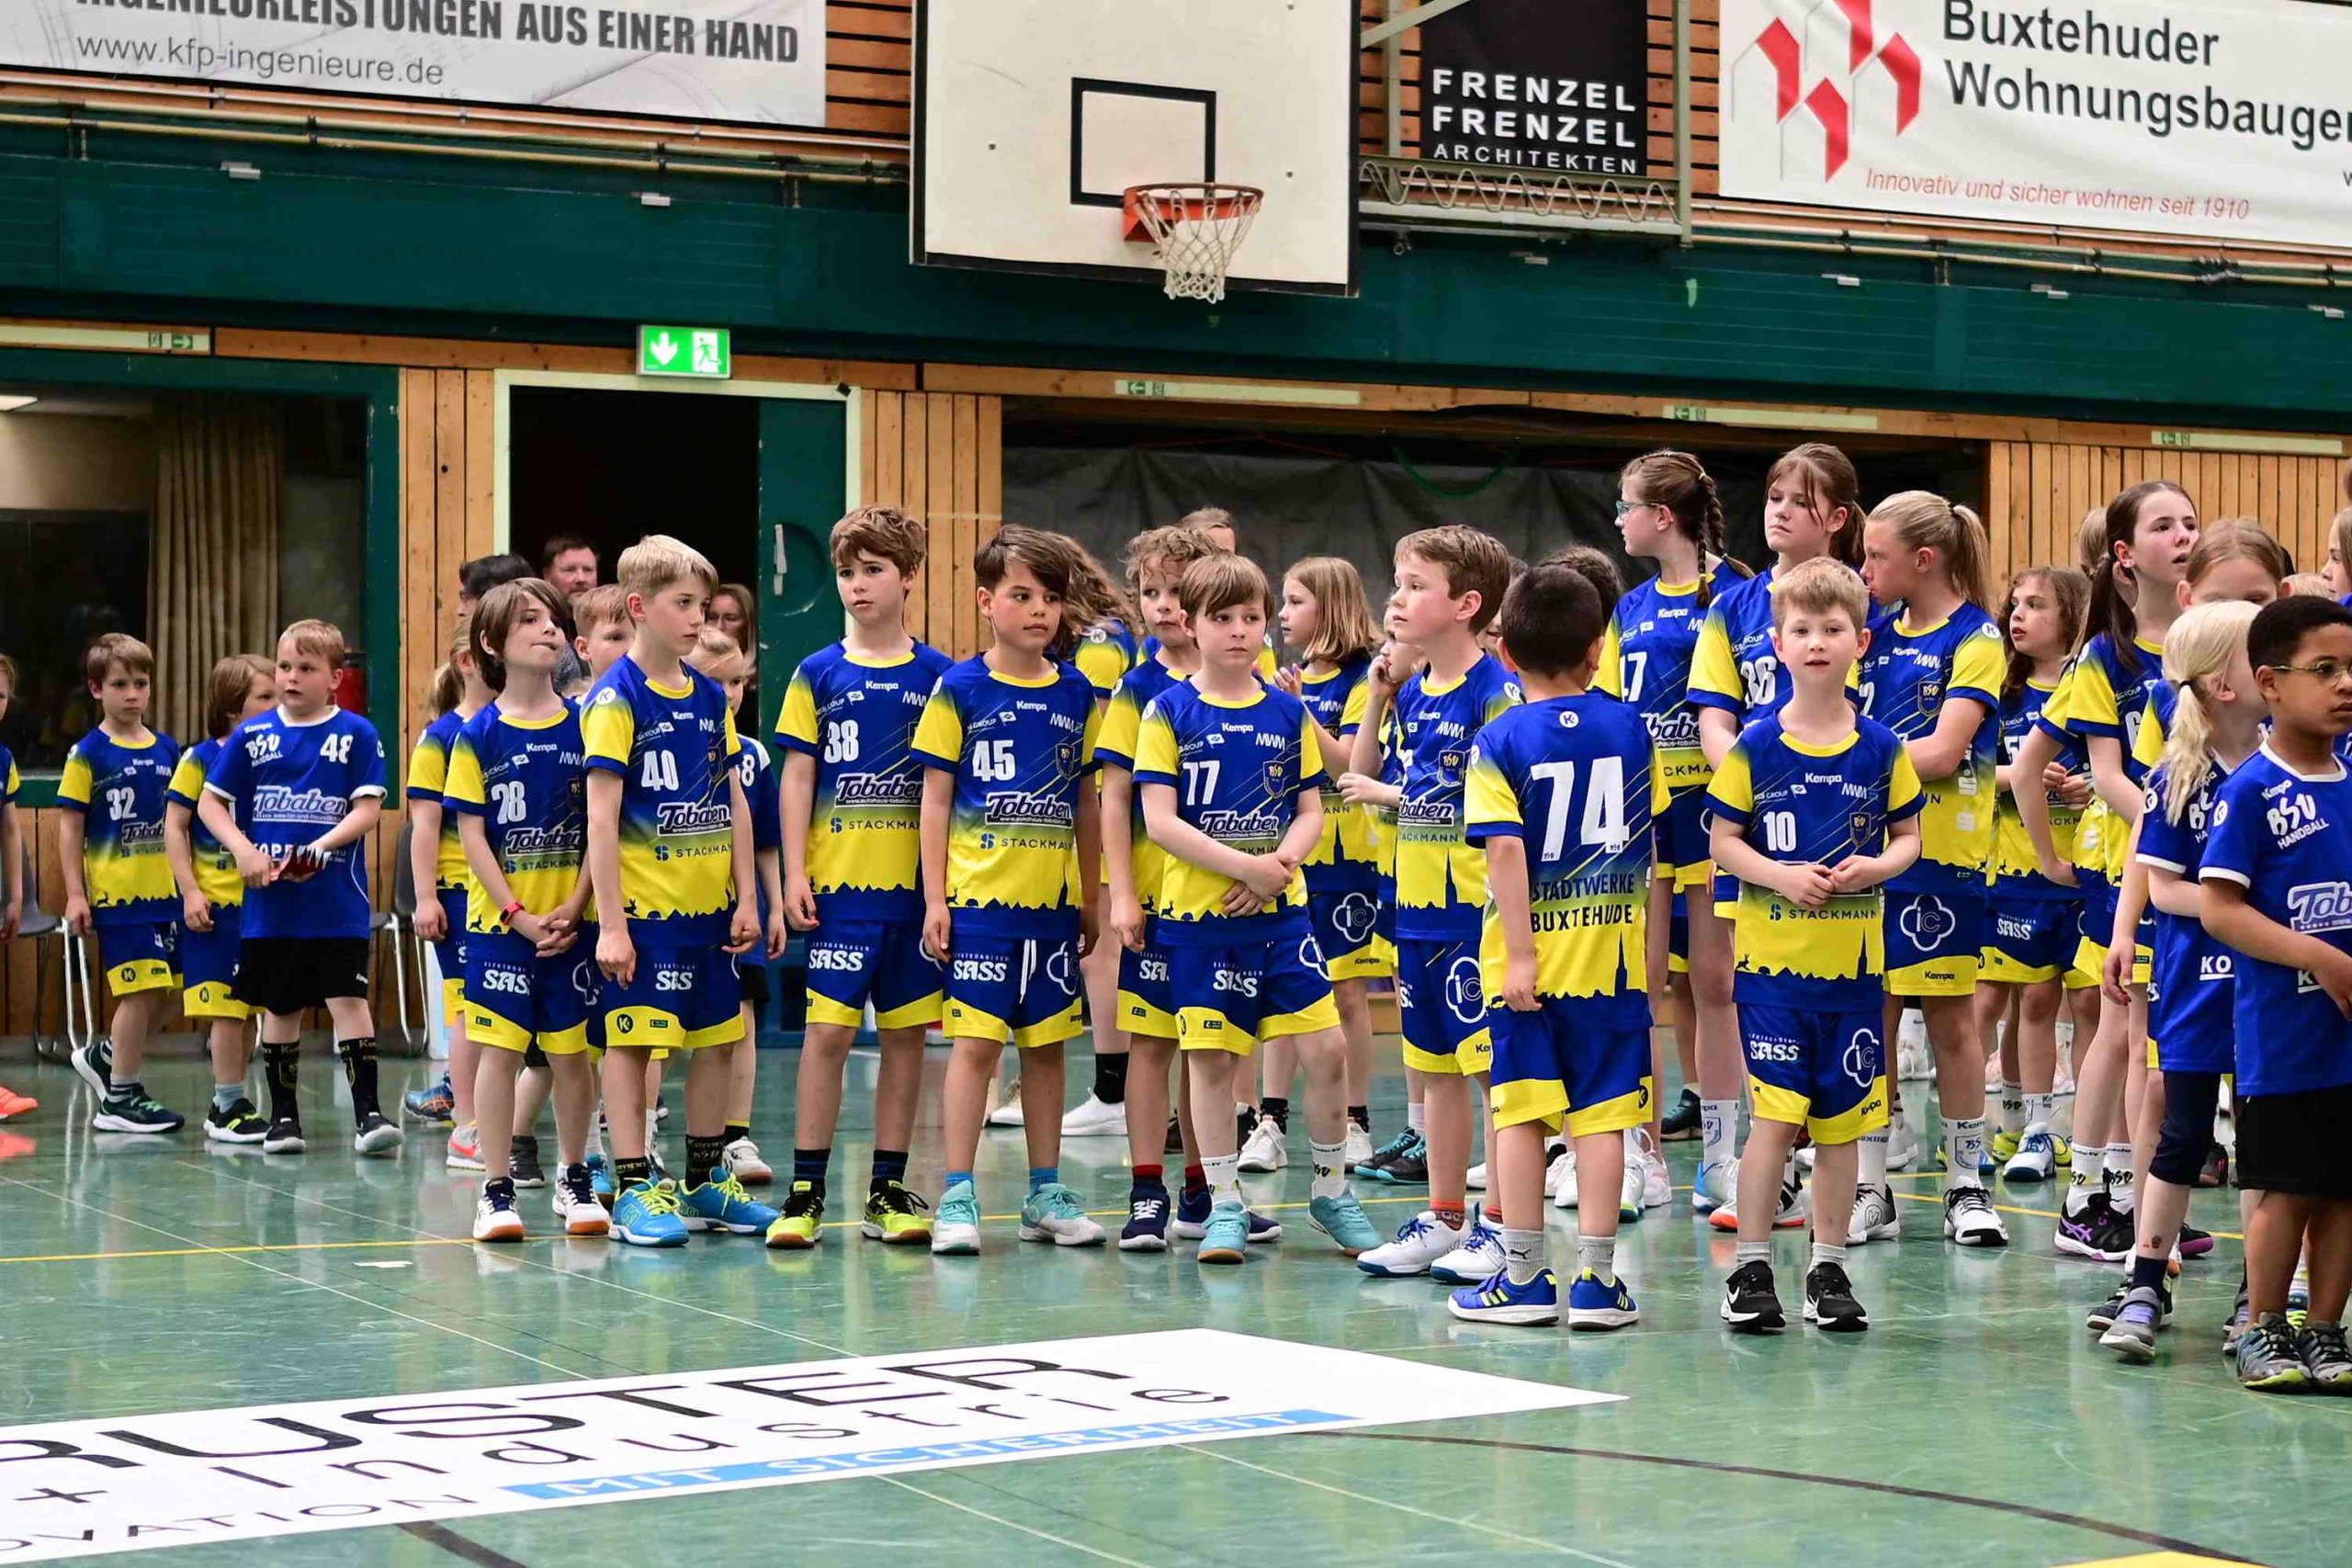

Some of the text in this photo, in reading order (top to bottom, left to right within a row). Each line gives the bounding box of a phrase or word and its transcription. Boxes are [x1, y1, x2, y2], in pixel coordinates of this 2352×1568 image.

[77, 0, 798, 62] RLEISTUNGEN AUS EINER HAND
[1943, 0, 2219, 66] Buxtehuder
[77, 37, 444, 85] www.kfp-ingenieure.de
[1432, 68, 1636, 112] FRENZEL
[1944, 59, 2352, 151] Wohnungsbauge
[1432, 106, 1636, 148] FRENZEL
[1433, 142, 1637, 175] ARCHITEKTEN
[1866, 168, 2250, 220] Innovativ und sicher wohnen seit 1910
[1657, 608, 1689, 619] Kempa
[865, 680, 899, 692] Kempa
[1016, 700, 1047, 712] Kempa
[824, 719, 859, 763] 38
[1221, 722, 1254, 734] Kempa
[320, 733, 354, 764] 48
[526, 742, 558, 752] Kempa
[972, 739, 1016, 782] 45
[641, 750, 680, 792] 40
[1804, 773, 1842, 785] Kempa
[107, 786, 138, 821] 32
[256, 787, 347, 815] Tobaben
[987, 792, 1070, 820] Tobaben
[1530, 756, 1630, 862] 74
[2267, 793, 2317, 836] BSV
[1763, 811, 1797, 852] 10
[2277, 818, 2330, 851] HANDBALL
[1532, 874, 1634, 903] STADTWERKE
[1532, 905, 1633, 932] BUXTEHUDE
[1789, 908, 1876, 919] STACKMANN
[808, 949, 863, 972] SASS
[954, 959, 1007, 983] SASS
[1924, 971, 1955, 984] Kempa
[1750, 1040, 1800, 1061] SASS
[546, 1413, 1300, 1495] MIT SICHERHEIT
